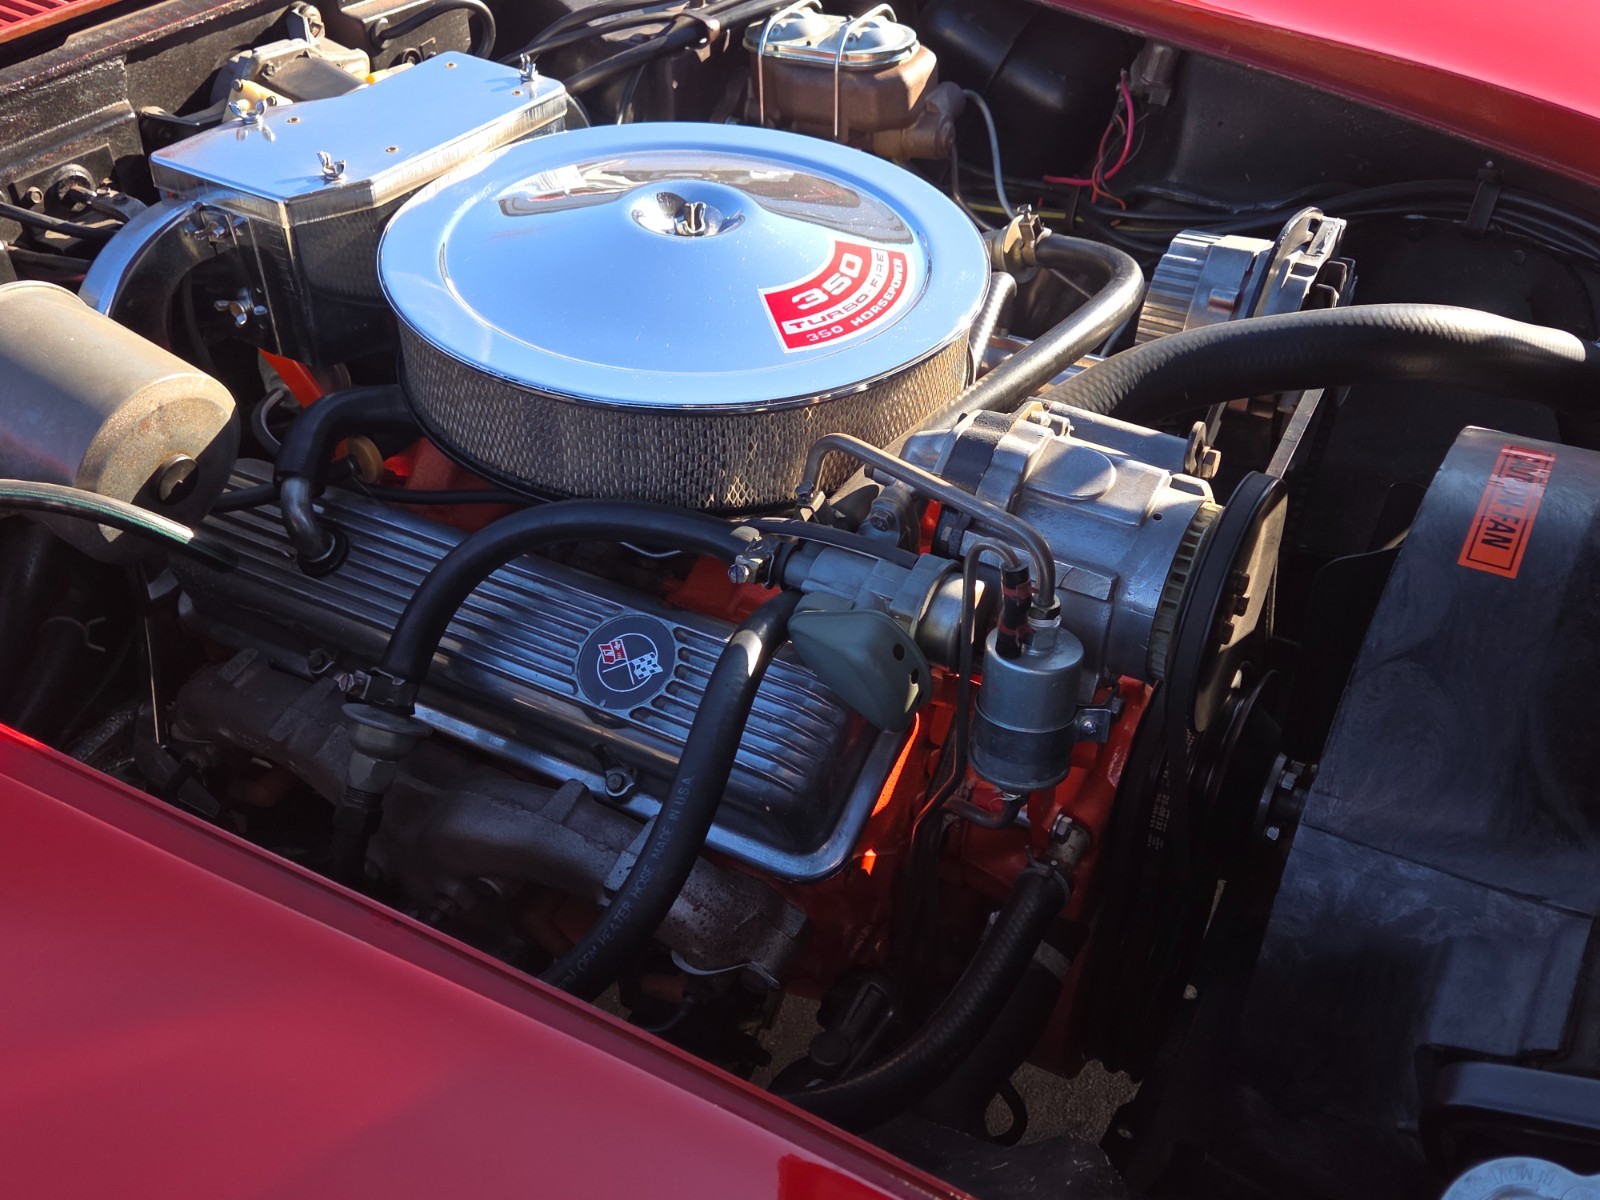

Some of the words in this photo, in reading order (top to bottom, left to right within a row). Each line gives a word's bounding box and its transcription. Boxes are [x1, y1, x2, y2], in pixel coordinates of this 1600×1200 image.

[788, 252, 884, 330] TURBO-FIRE
[791, 252, 863, 311] 350
[806, 324, 844, 342] 350
[850, 257, 904, 327] HORSEPOWER
[600, 900, 633, 946] HEATER
[630, 865, 655, 900] HOSE
[652, 826, 675, 861] MADE
[669, 808, 682, 822] IN
